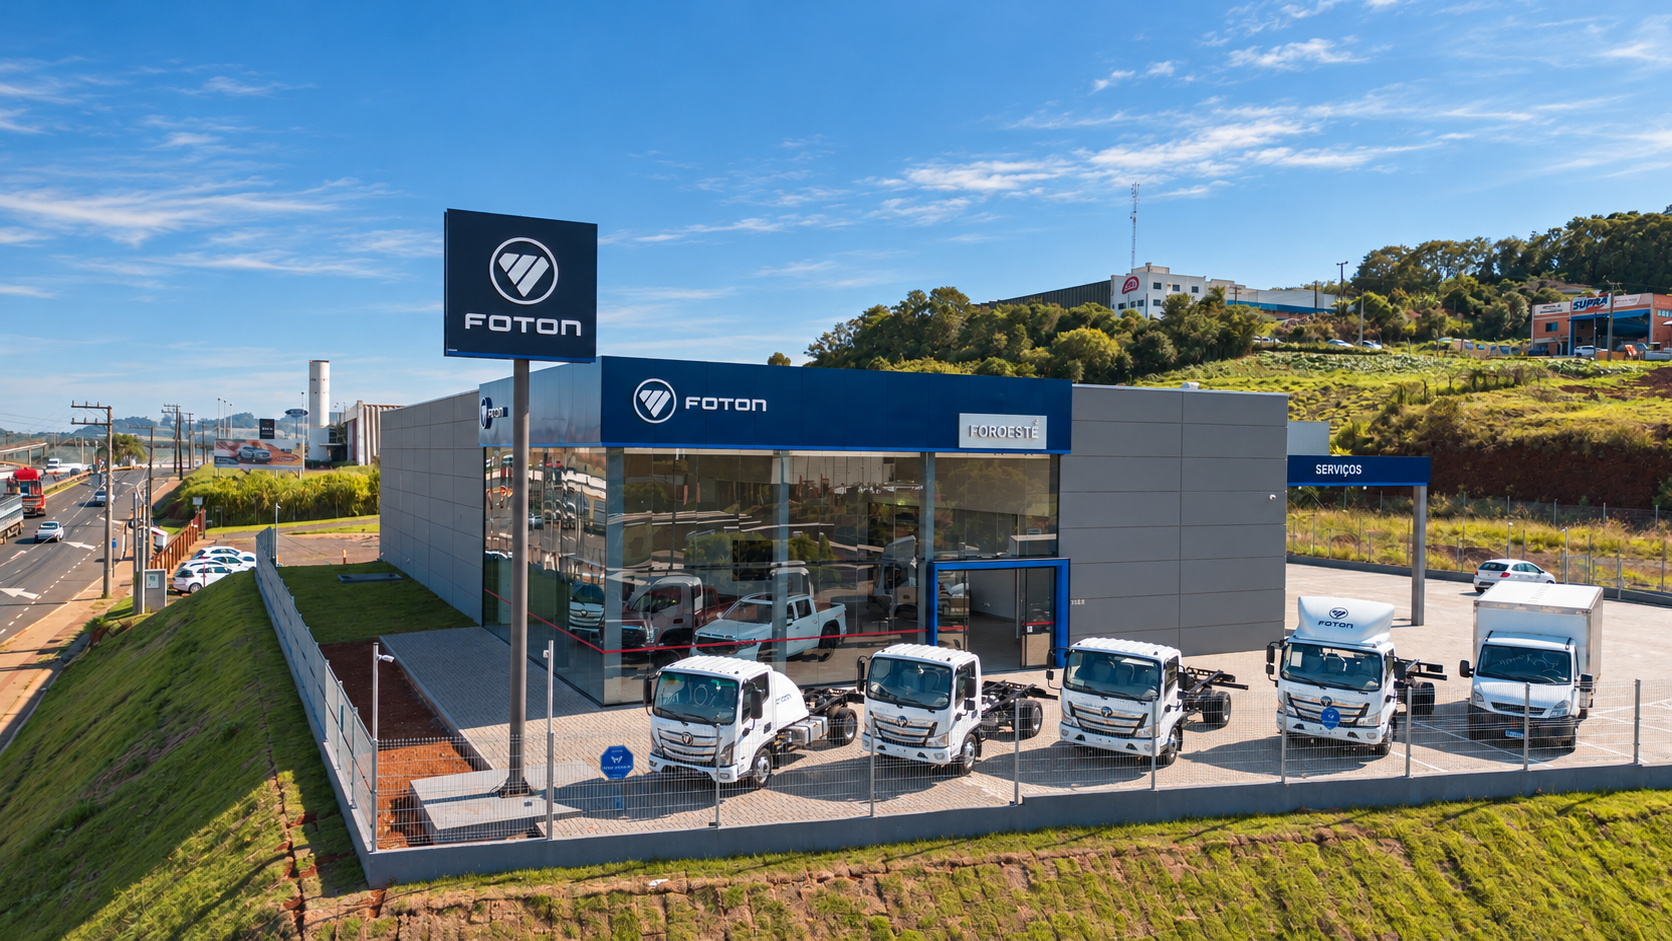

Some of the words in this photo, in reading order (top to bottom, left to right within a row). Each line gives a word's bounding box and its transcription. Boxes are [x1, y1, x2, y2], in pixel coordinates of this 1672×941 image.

[1572, 296, 1609, 311] SUPRA
[464, 312, 582, 337] FOTON
[685, 396, 767, 412] FOTON
[1315, 463, 1362, 478] SERVIÇOS
[1317, 620, 1354, 629] FOTON
